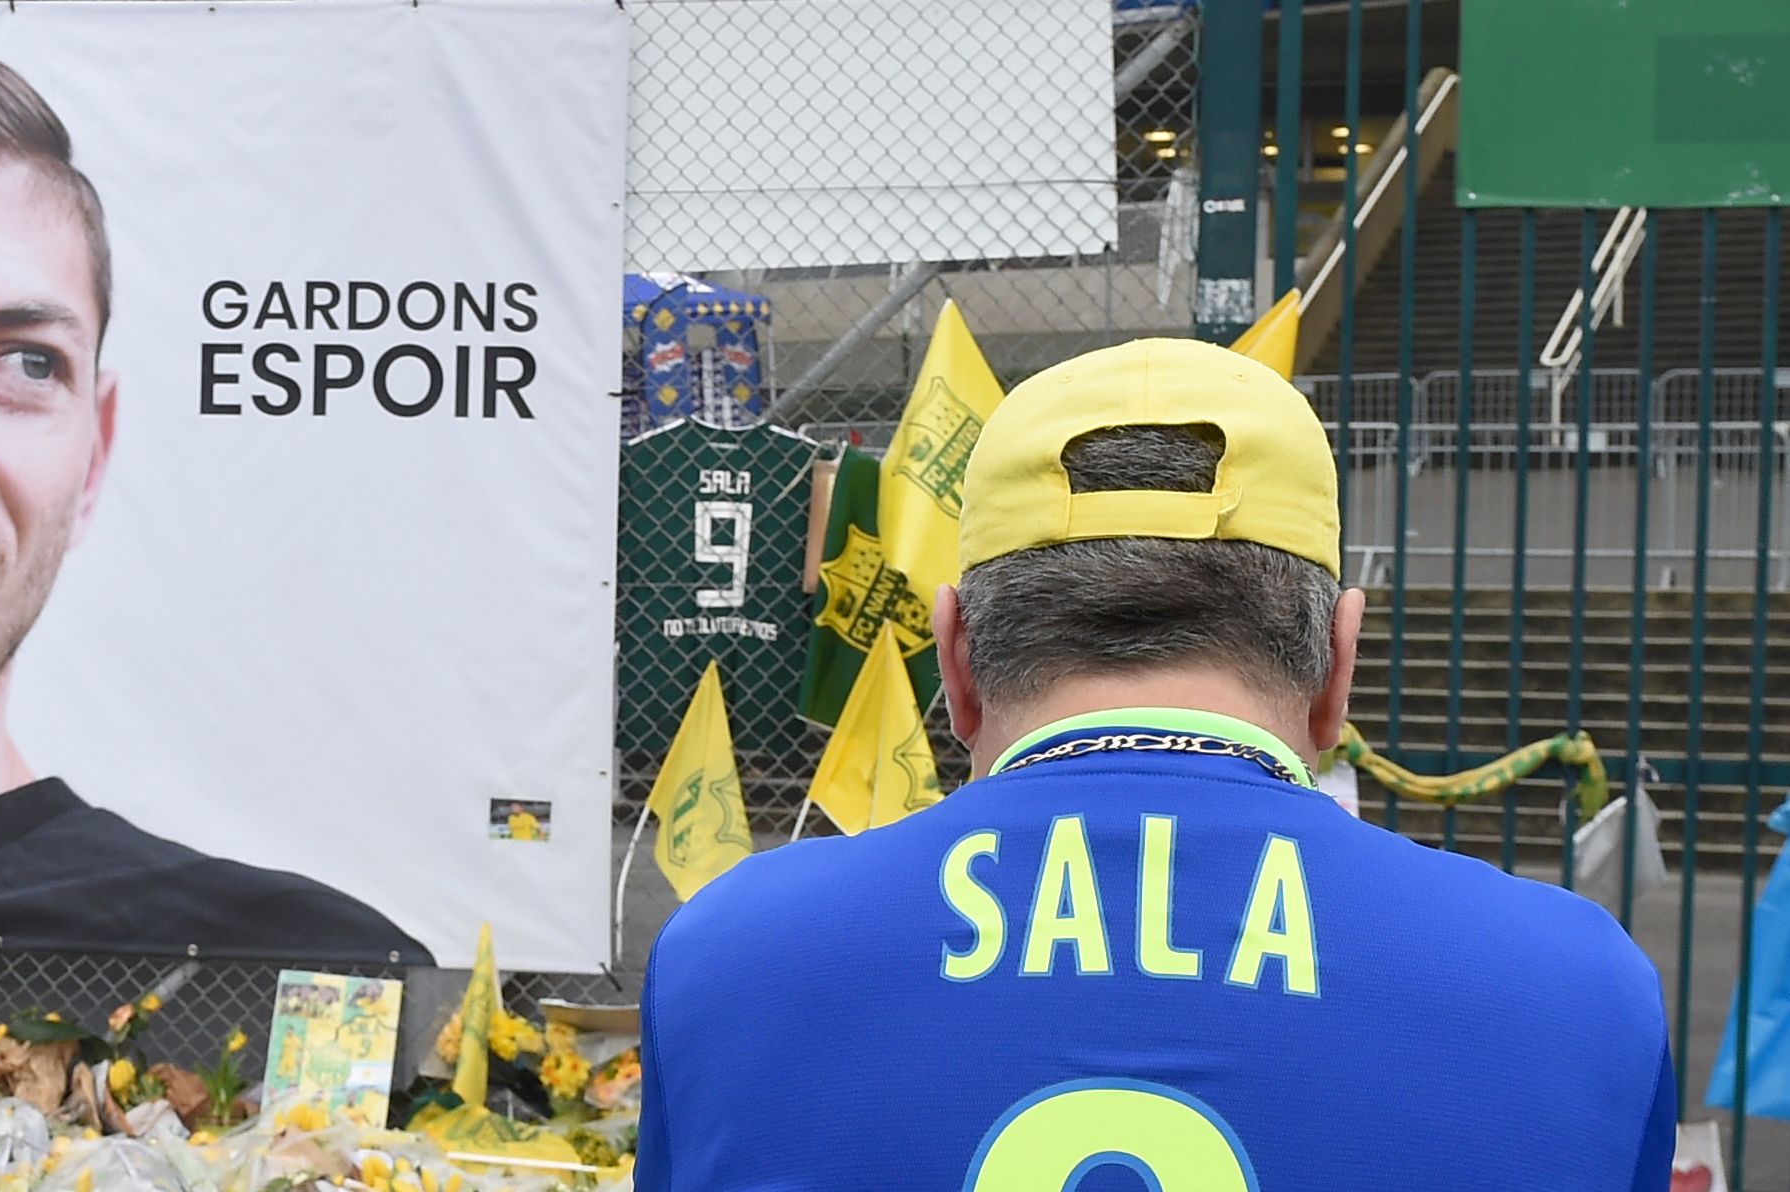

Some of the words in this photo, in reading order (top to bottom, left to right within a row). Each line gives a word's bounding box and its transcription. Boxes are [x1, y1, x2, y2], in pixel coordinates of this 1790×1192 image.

[201, 279, 539, 333] GARDONS
[199, 342, 538, 420] ESPOIR
[698, 469, 752, 495] SALA
[694, 500, 754, 609] 9
[850, 616, 876, 644] FC
[939, 811, 1322, 999] SALA
